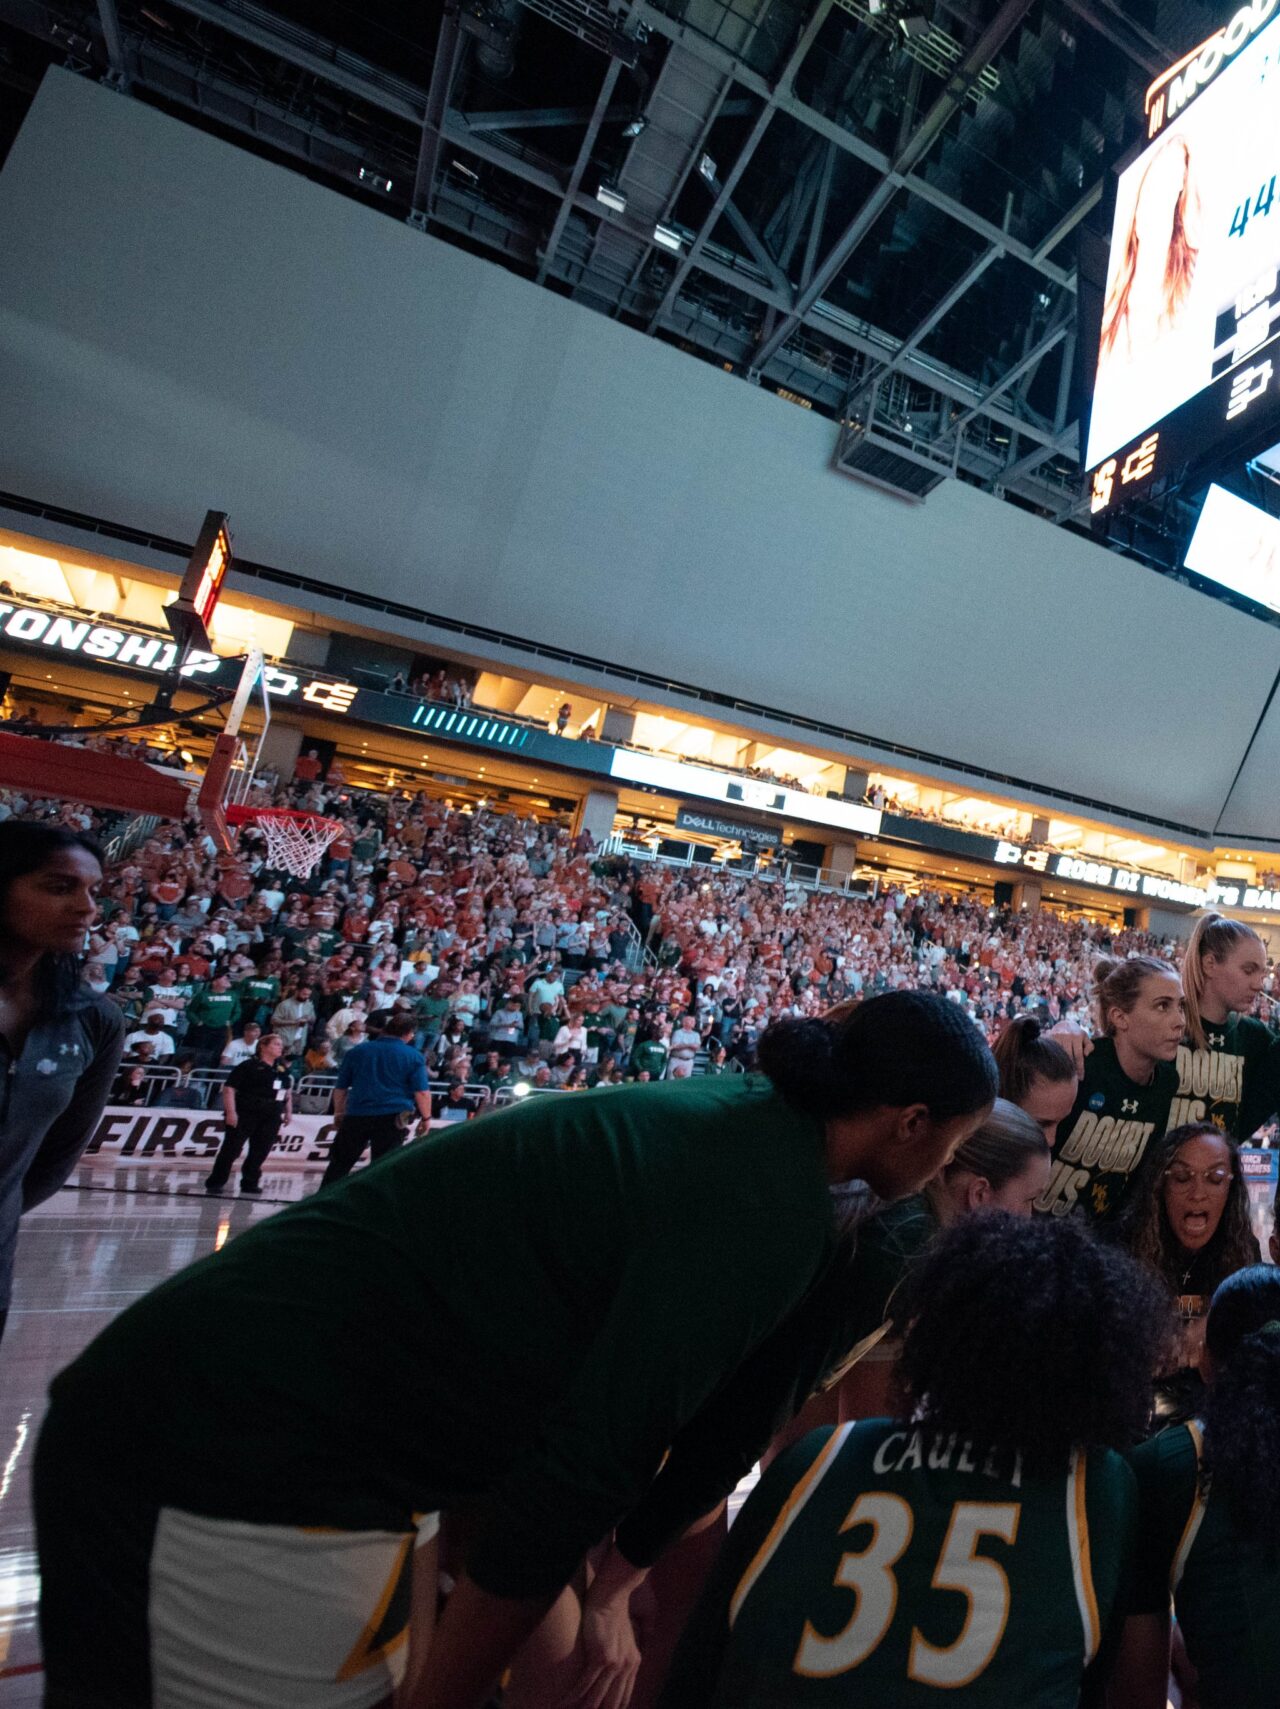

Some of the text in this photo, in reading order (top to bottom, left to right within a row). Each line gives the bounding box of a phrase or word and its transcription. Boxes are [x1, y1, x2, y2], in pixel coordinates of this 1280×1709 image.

[1229, 174, 1276, 238] 44
[1176, 1044, 1245, 1103] DOUBT
[1059, 1109, 1156, 1174] DOUBT
[1033, 1160, 1091, 1217] US
[793, 1490, 1022, 1689] 35
